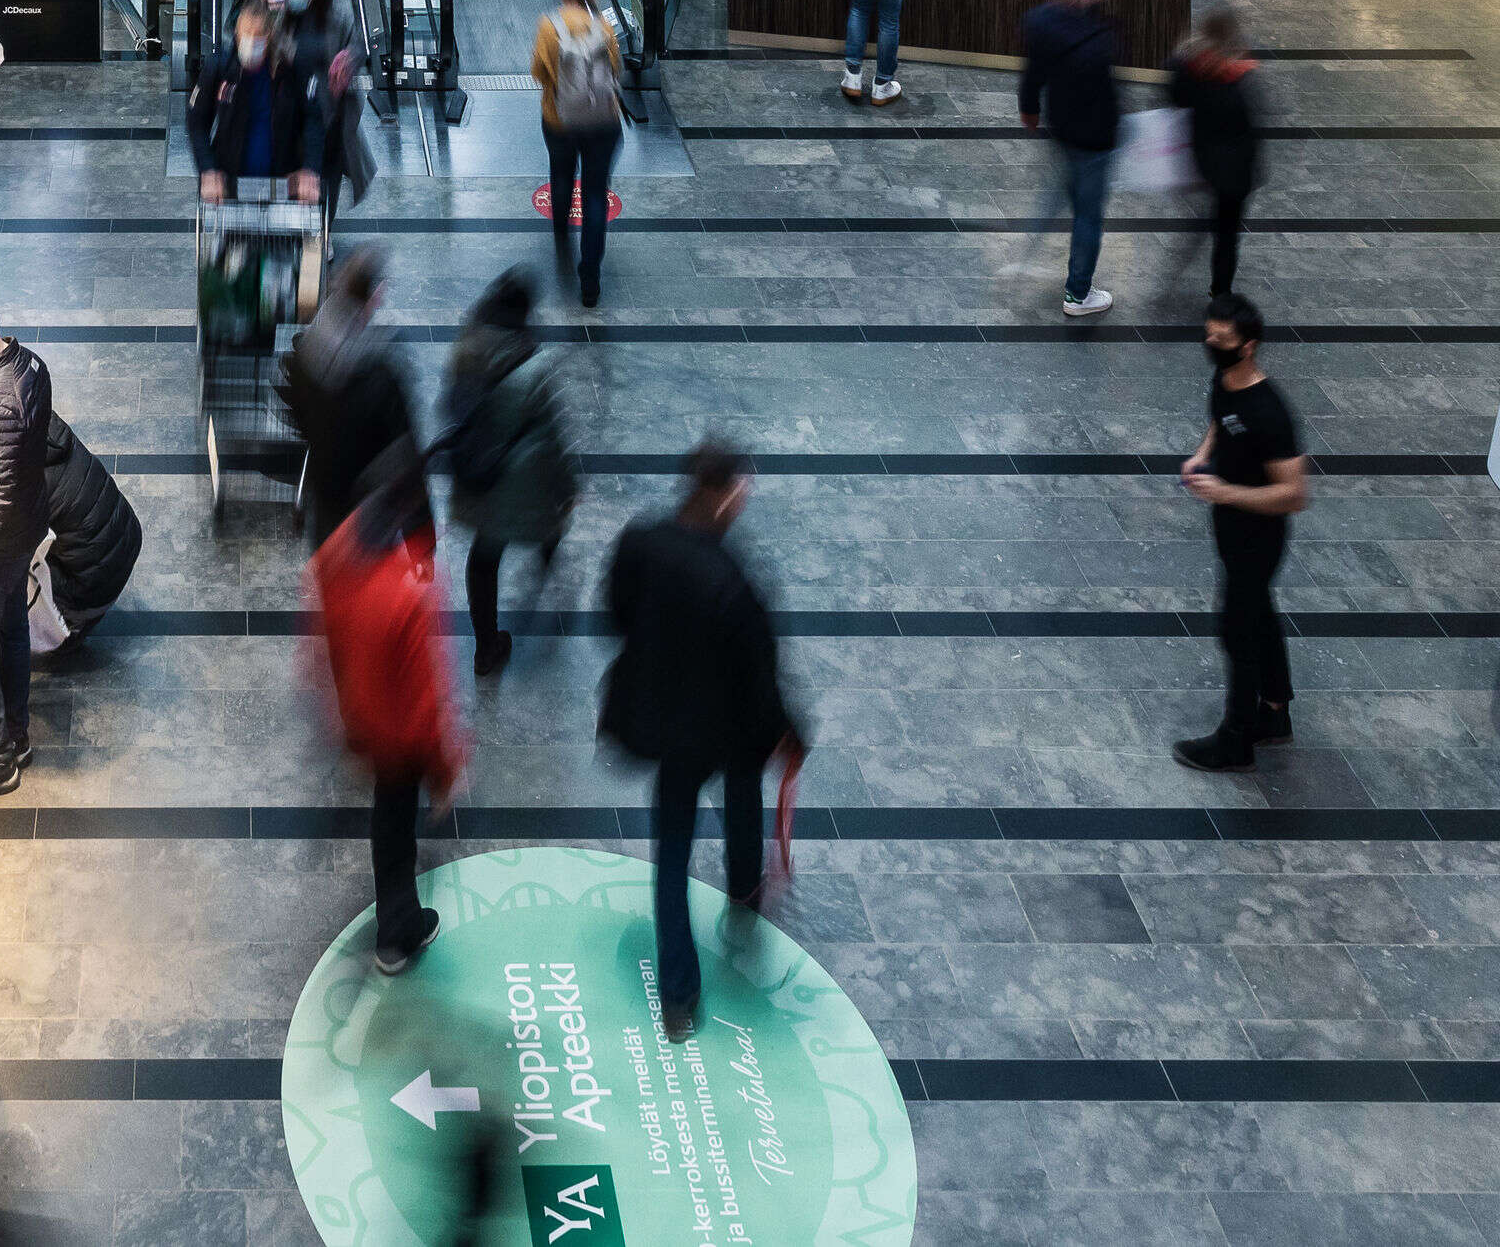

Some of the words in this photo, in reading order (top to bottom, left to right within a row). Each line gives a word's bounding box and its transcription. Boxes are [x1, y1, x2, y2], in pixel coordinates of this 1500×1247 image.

[513, 962, 558, 1153] Yliopiston
[561, 962, 612, 1132] Apteekki
[622, 1026, 654, 1096] meidät
[638, 958, 681, 1094] metroaseman
[638, 1102, 671, 1175] Löydät
[683, 1038, 740, 1217] bussiterminaalin
[712, 1015, 795, 1186] Tervetuloa!
[543, 1173, 605, 1247] YA
[727, 1223, 752, 1245] ja
